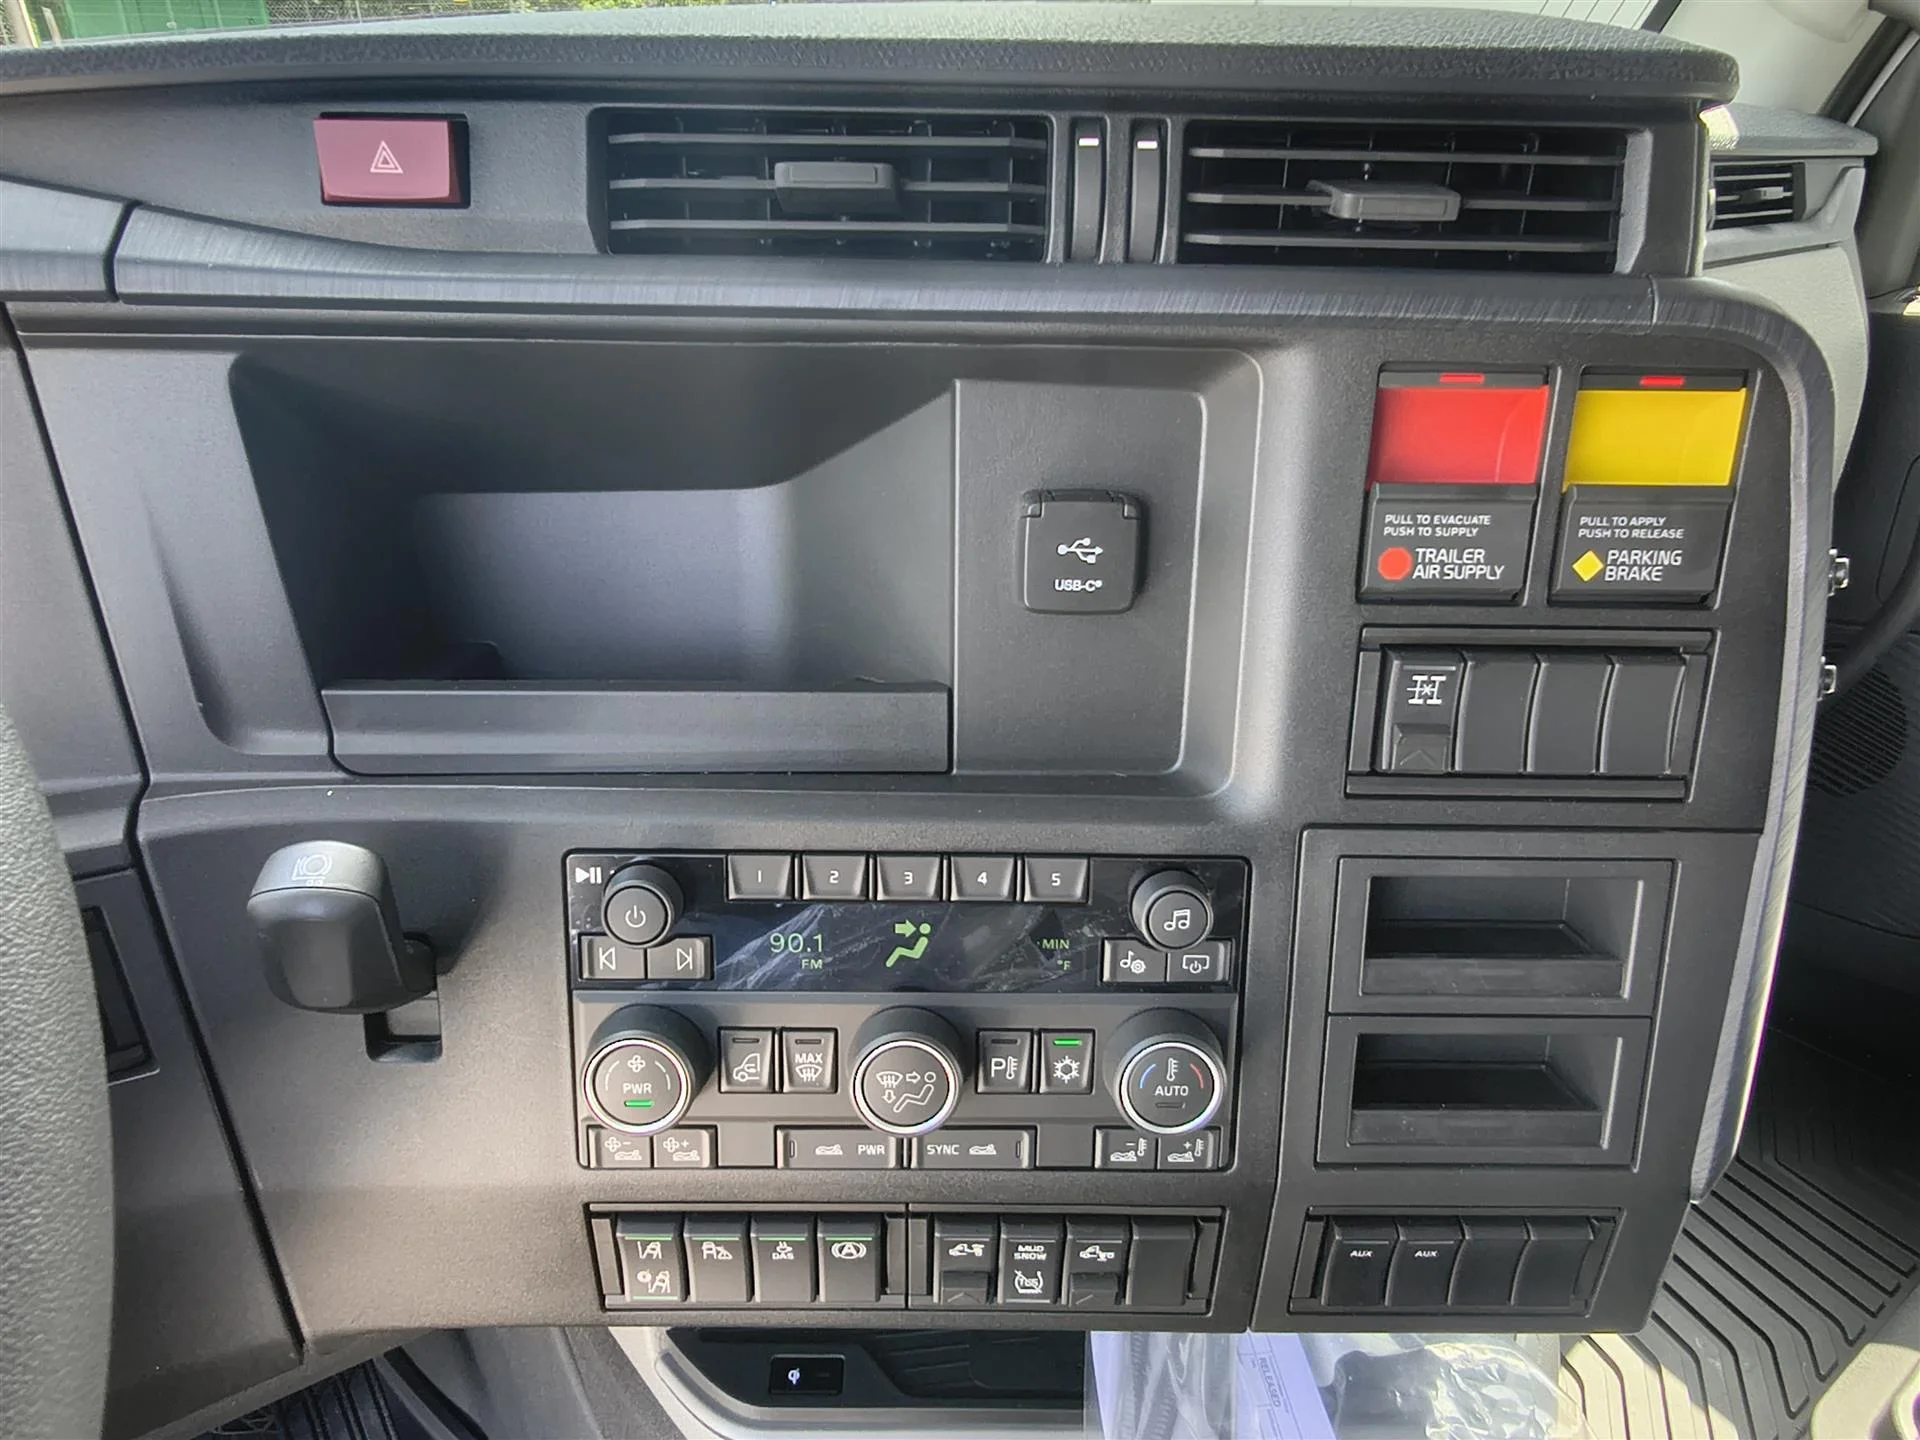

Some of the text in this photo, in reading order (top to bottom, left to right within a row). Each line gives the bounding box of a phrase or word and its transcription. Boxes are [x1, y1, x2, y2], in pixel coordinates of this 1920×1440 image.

[1385, 514, 1492, 526] PULL TO EVACUATE
[1579, 516, 1667, 527] PULL TO APPLY
[1383, 526, 1479, 538] PUSH TO SUPPLY
[1578, 528, 1685, 539] PUSH TO RELEASE
[1415, 548, 1486, 564] TRAILER
[1607, 549, 1683, 566] PARKING
[1412, 564, 1505, 580] AIR SUPPLY
[1604, 566, 1664, 582] BRAKE
[757, 870, 763, 883] 1
[829, 870, 840, 884] 2
[903, 871, 914, 885] 3
[977, 871, 988, 885] 4
[1051, 872, 1062, 886] 5
[769, 932, 824, 954] 90.1
[1042, 938, 1070, 949] MIN
[801, 959, 823, 970] FM
[795, 1052, 824, 1065] MAX
[622, 1082, 653, 1095] PWR
[1154, 1084, 1190, 1097] AUTO
[857, 1143, 886, 1156] PWR
[926, 1143, 960, 1156] SYNC
[771, 1252, 795, 1261] DAS
[1014, 1252, 1048, 1261] SNOW
[1349, 1249, 1373, 1258] AUX
[1414, 1249, 1439, 1258] AUX
[1258, 1357, 1282, 1408] RELEASED
